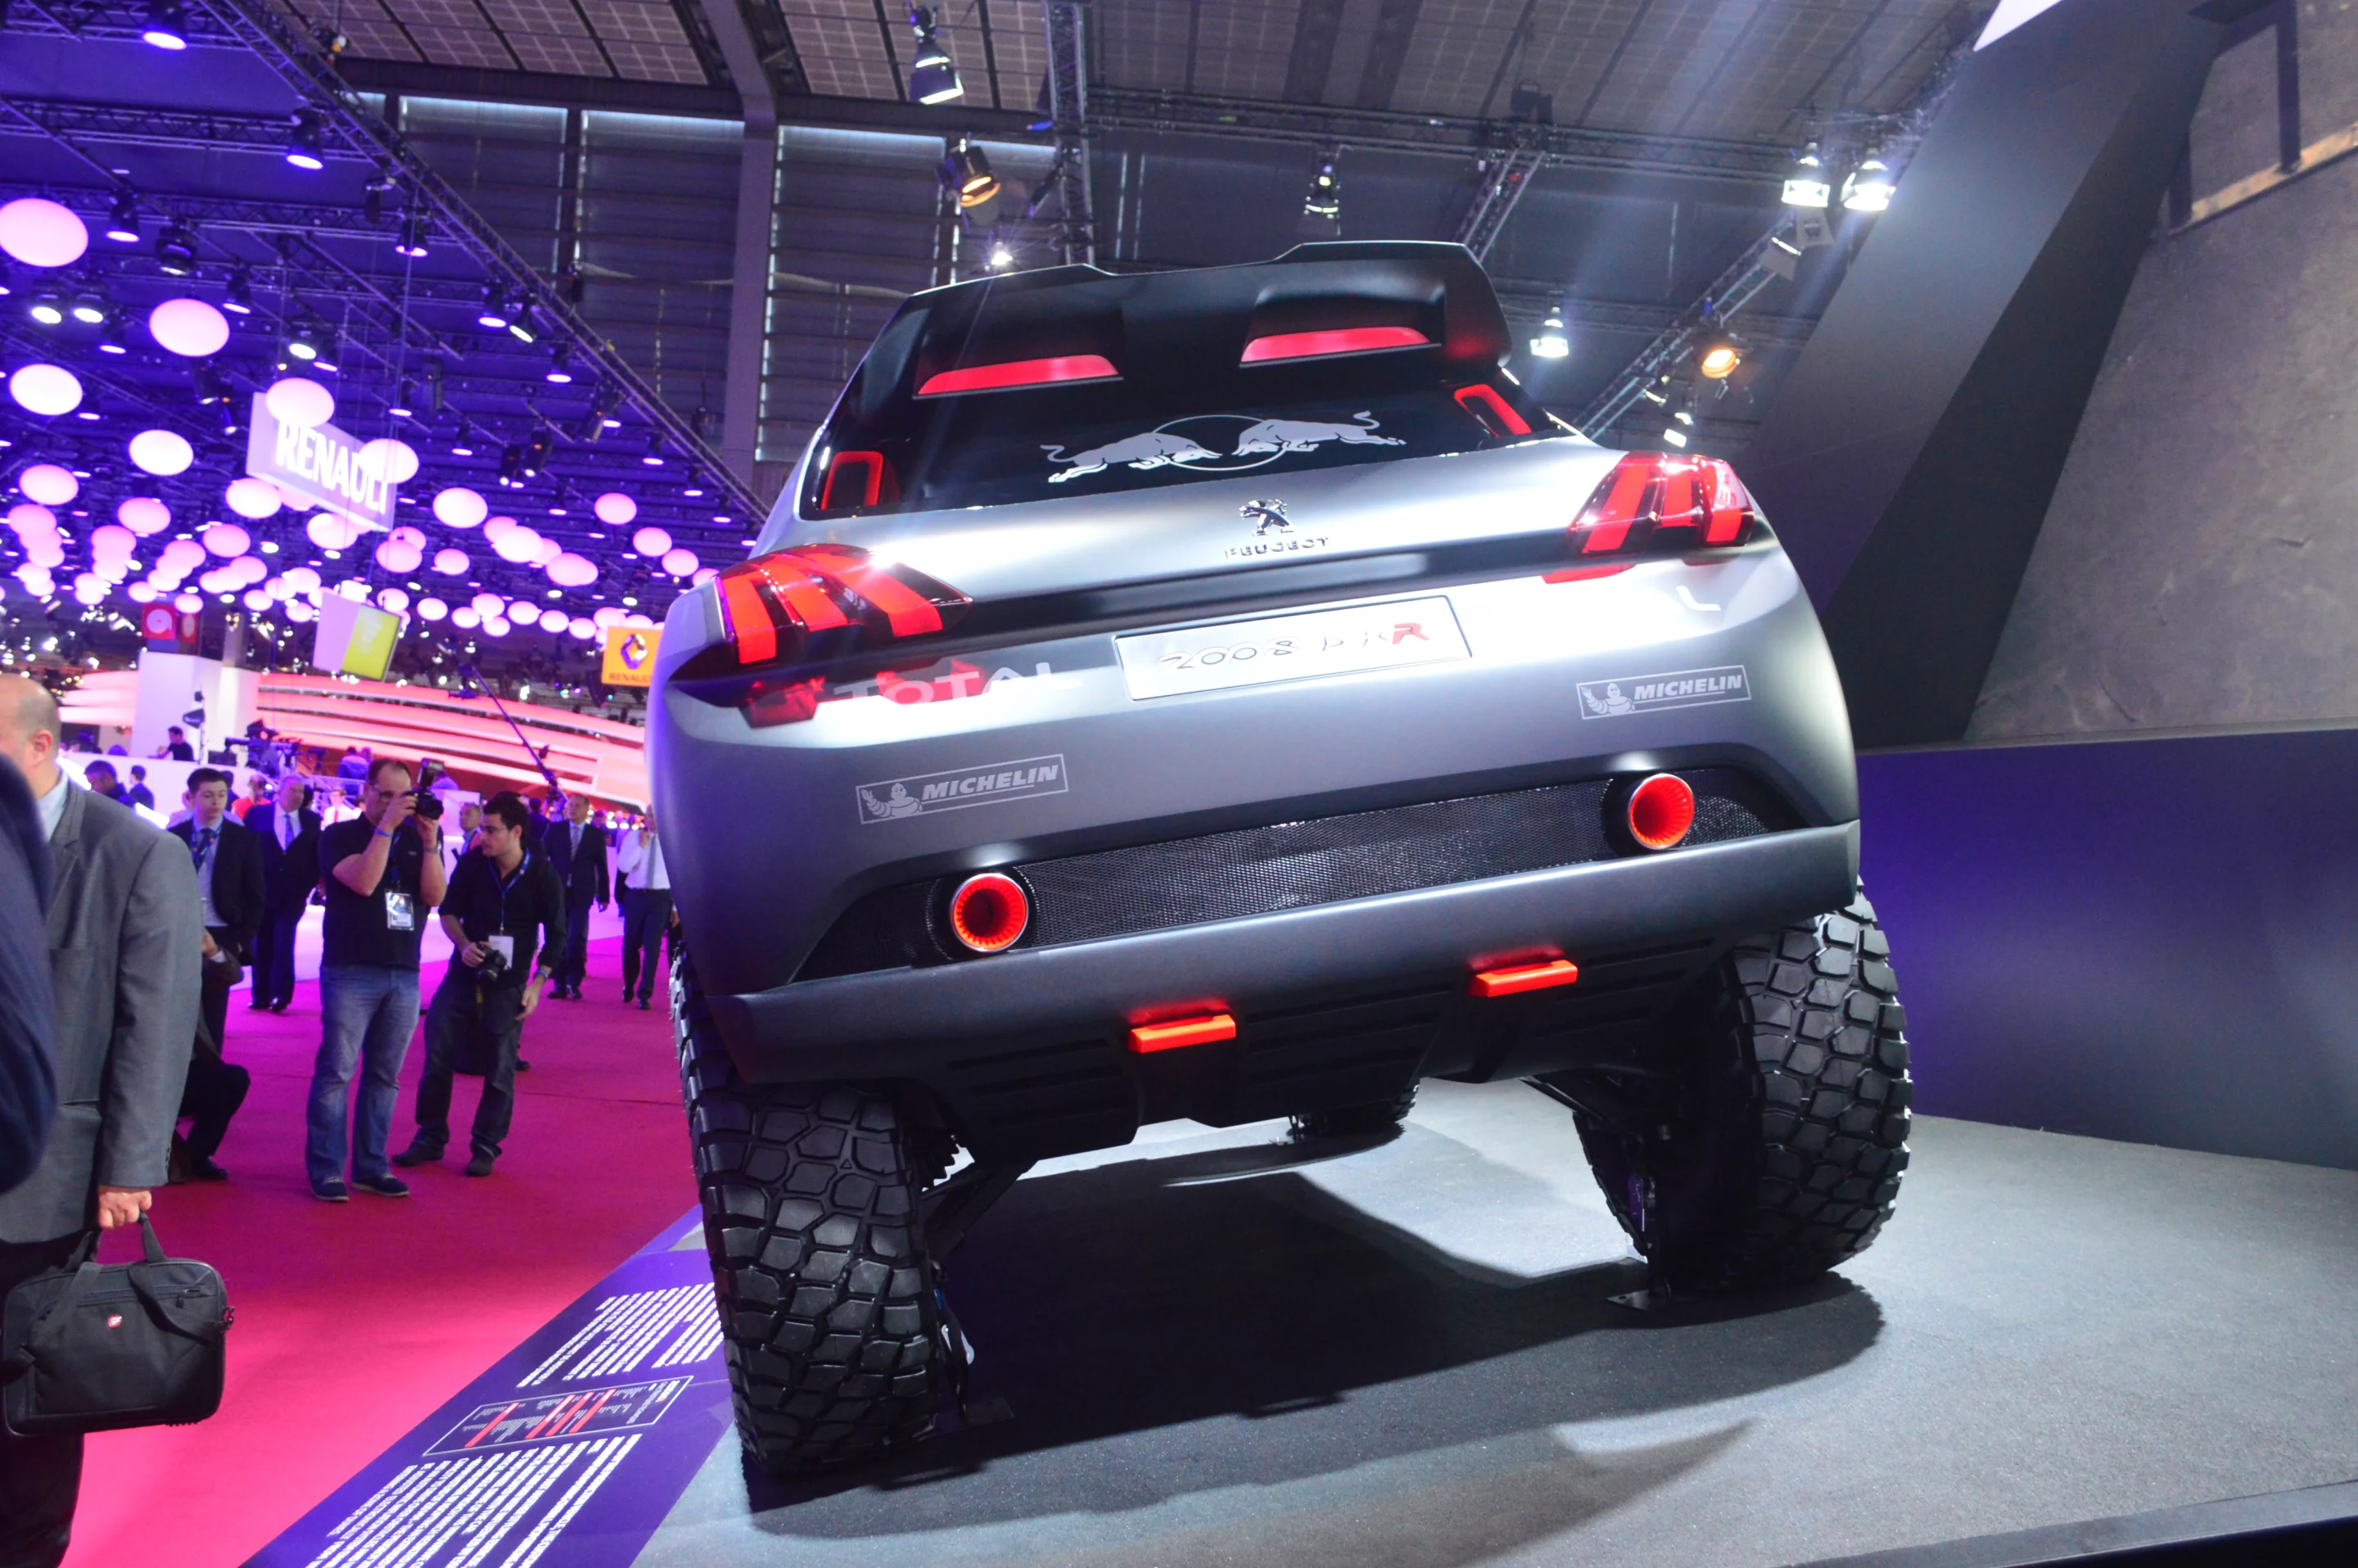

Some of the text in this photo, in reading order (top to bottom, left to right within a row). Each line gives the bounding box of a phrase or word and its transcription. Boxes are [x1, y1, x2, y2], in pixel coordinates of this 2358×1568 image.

[1159, 636, 1301, 674] 2008
[1634, 674, 1742, 700] MICHELIN
[922, 764, 1059, 801] MICHELIN
